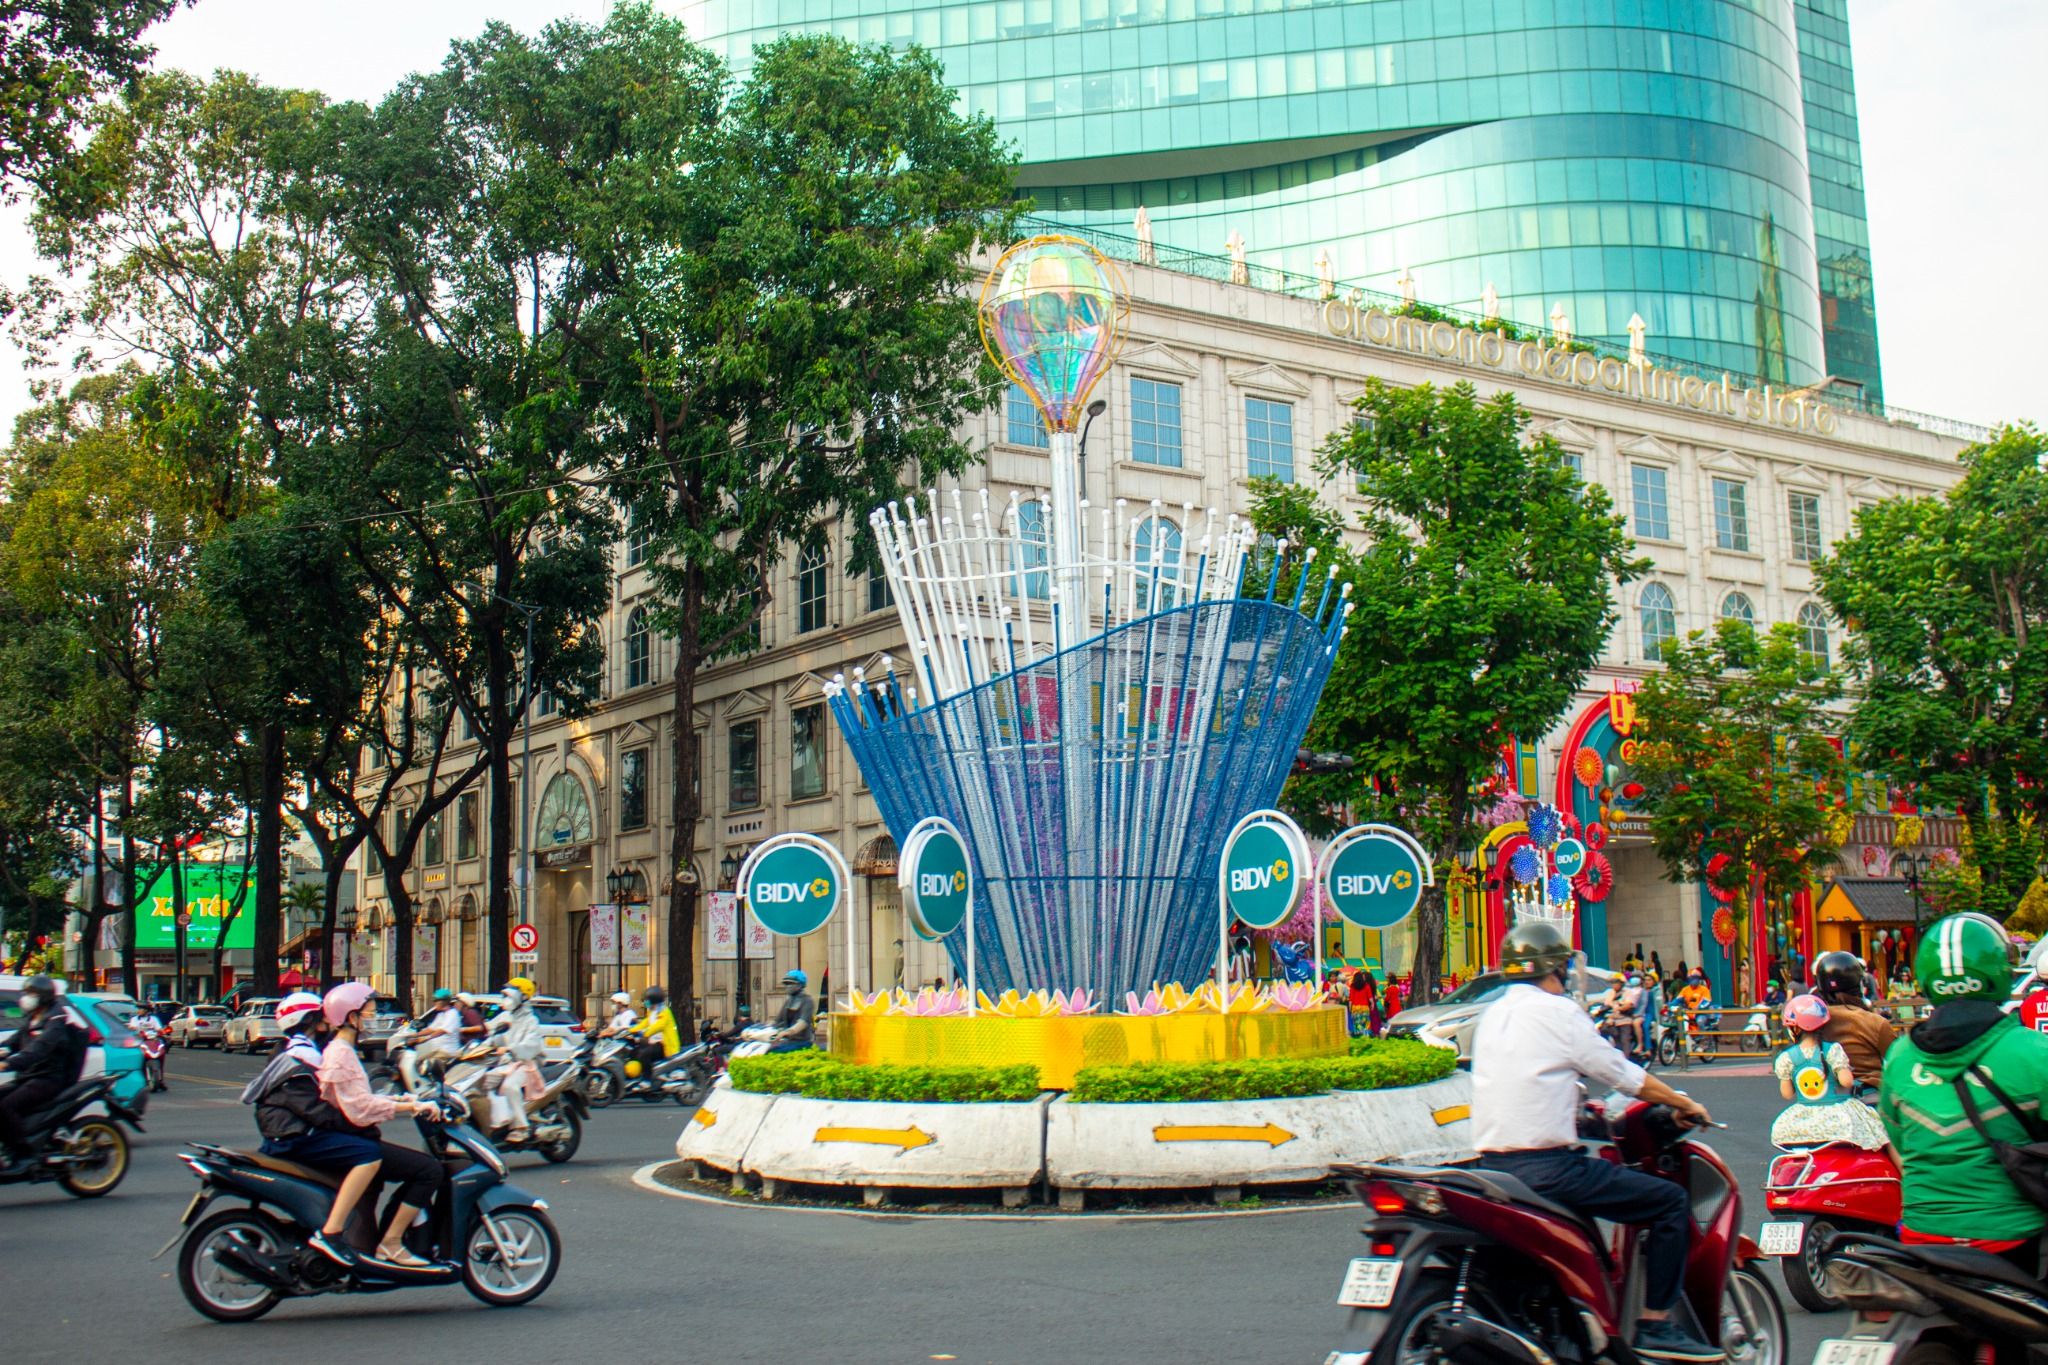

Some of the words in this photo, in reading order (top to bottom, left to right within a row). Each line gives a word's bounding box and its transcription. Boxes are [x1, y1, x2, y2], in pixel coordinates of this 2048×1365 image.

[1324, 288, 1505, 366] diamond
[1518, 337, 1735, 415] department
[1744, 384, 1837, 435] store
[728, 820, 762, 834] RUNWAY
[1557, 854, 1574, 865] BIDV
[921, 873, 954, 896] BIDV
[1231, 865, 1273, 892] BIDV
[1337, 874, 1392, 896] BIDV
[756, 882, 811, 903] BIDV
[1932, 976, 1983, 995] Grab
